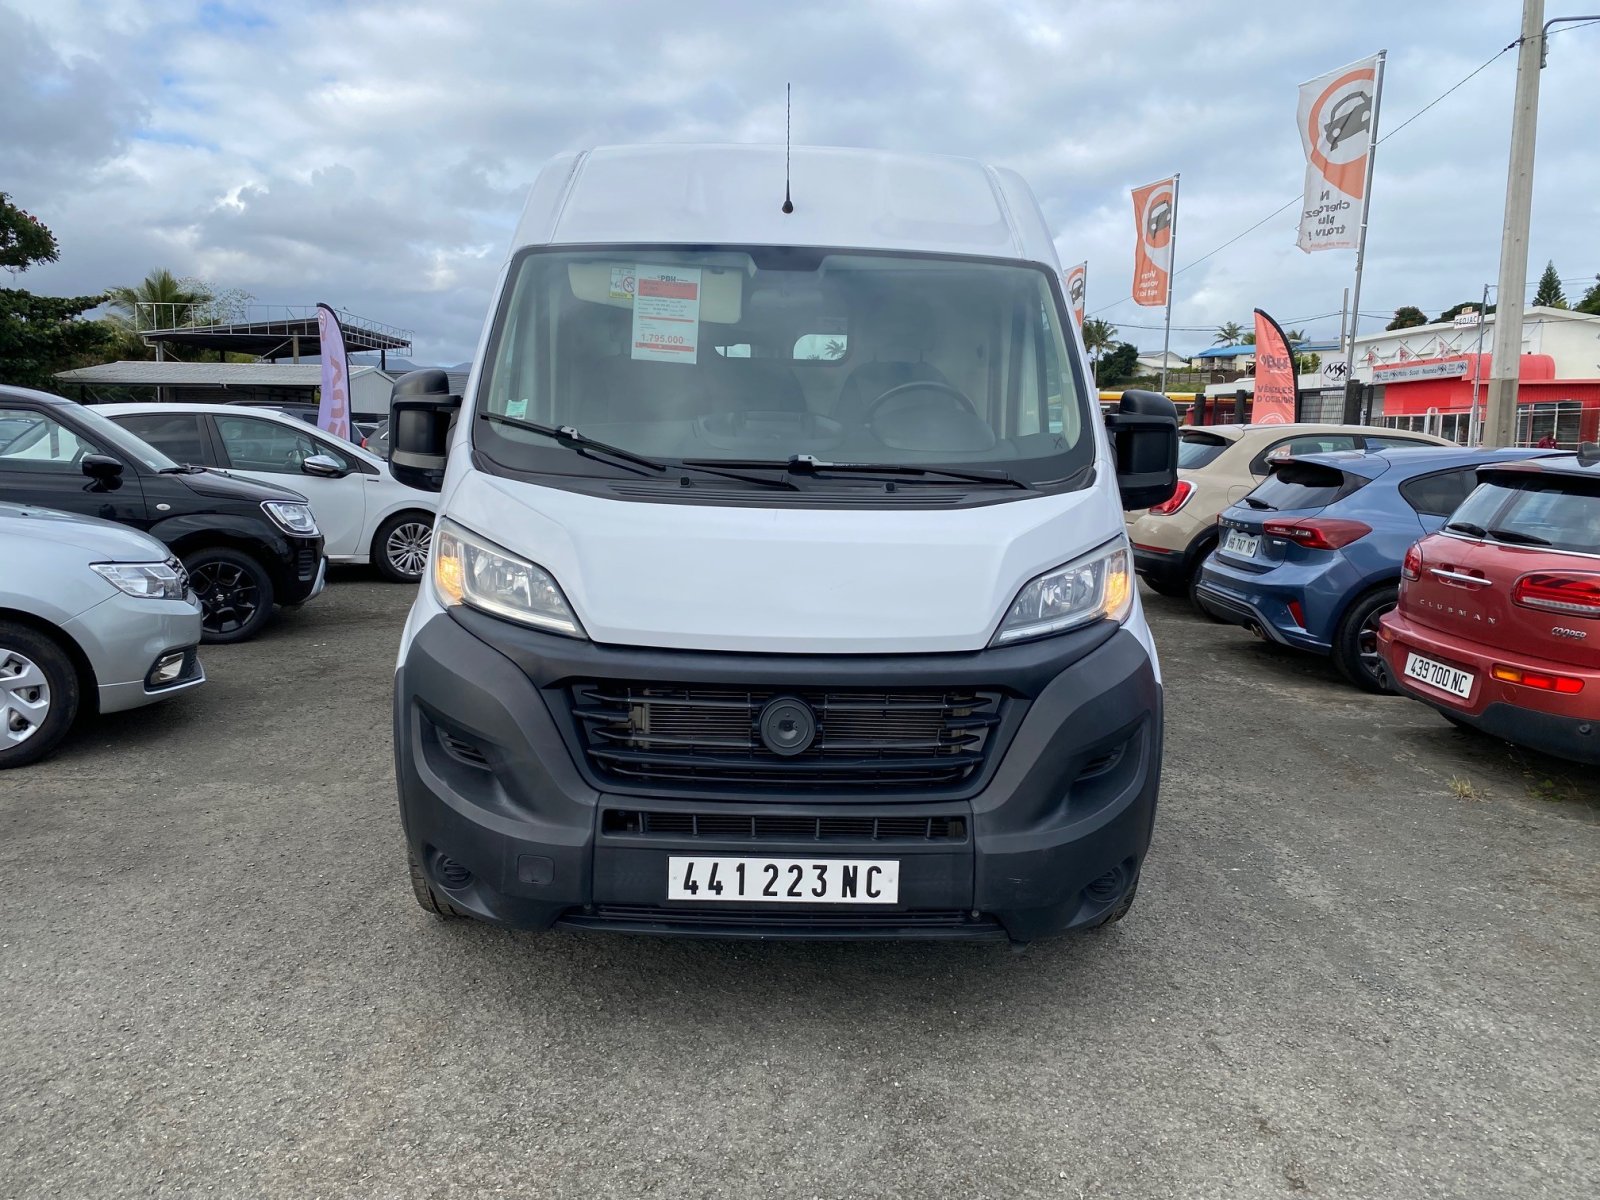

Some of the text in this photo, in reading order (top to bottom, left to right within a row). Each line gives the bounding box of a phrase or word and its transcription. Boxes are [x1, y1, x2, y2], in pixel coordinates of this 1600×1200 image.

[641, 334, 684, 344] 1.795.000
[1420, 599, 1496, 624] CLUBMAN
[1551, 627, 1587, 640] COOPER
[1410, 657, 1468, 694] 439 700 NC
[683, 862, 883, 899] 441 223 NC
